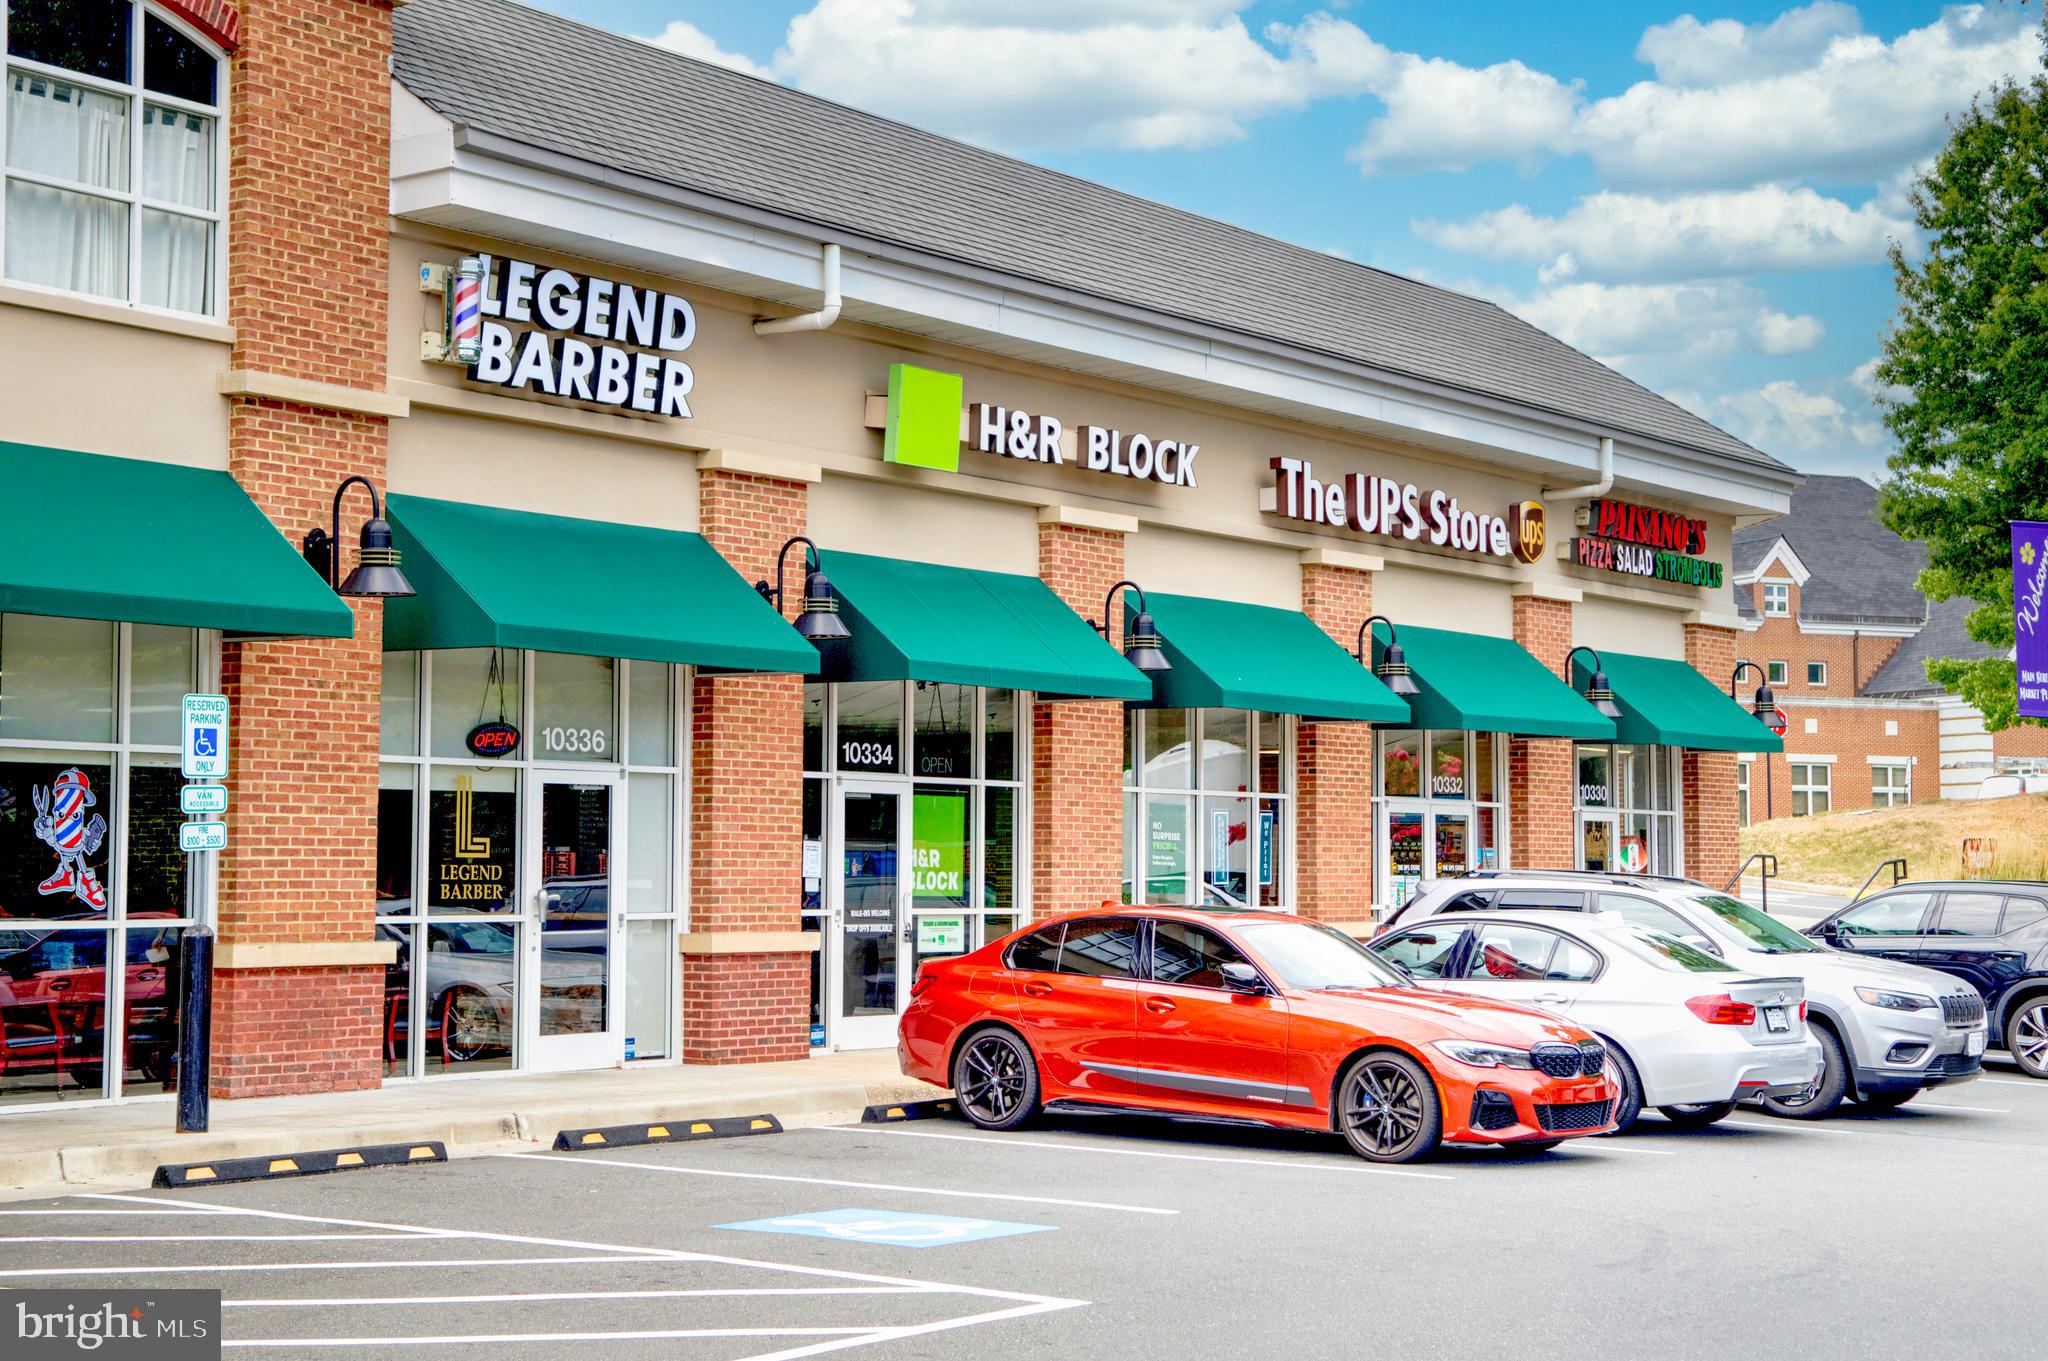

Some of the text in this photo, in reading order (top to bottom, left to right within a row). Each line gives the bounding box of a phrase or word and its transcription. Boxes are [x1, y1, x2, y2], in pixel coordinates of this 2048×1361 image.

[479, 253, 697, 352] LEGEND
[477, 321, 694, 418] BARBER
[979, 403, 1200, 488] H&R BLOCK
[1280, 457, 1508, 556] The UPS Store
[1597, 499, 1707, 555] PAISANO'S
[1521, 518, 1544, 554] ups
[1578, 538, 1723, 588] PIZZA SALAD STROMBOLIS
[187, 700, 226, 712] RESERVED
[190, 714, 222, 725] PARKING
[474, 731, 517, 748] OPEN
[542, 727, 605, 752] 10336
[842, 742, 893, 765] 10334
[196, 761, 214, 772] ONLY
[921, 756, 953, 773] OPEN
[1432, 776, 1463, 793] 10332
[1580, 784, 1607, 801] 10330
[199, 826, 208, 834] FINE
[1152, 822, 1162, 830] NO
[1263, 821, 1270, 837] We
[187, 836, 199, 845] $100
[207, 835, 220, 844] $500
[1152, 832, 1181, 841] SURPRISE
[441, 865, 502, 881] LEGEND
[912, 871, 959, 890] LOCK
[441, 884, 503, 900] BARBER
